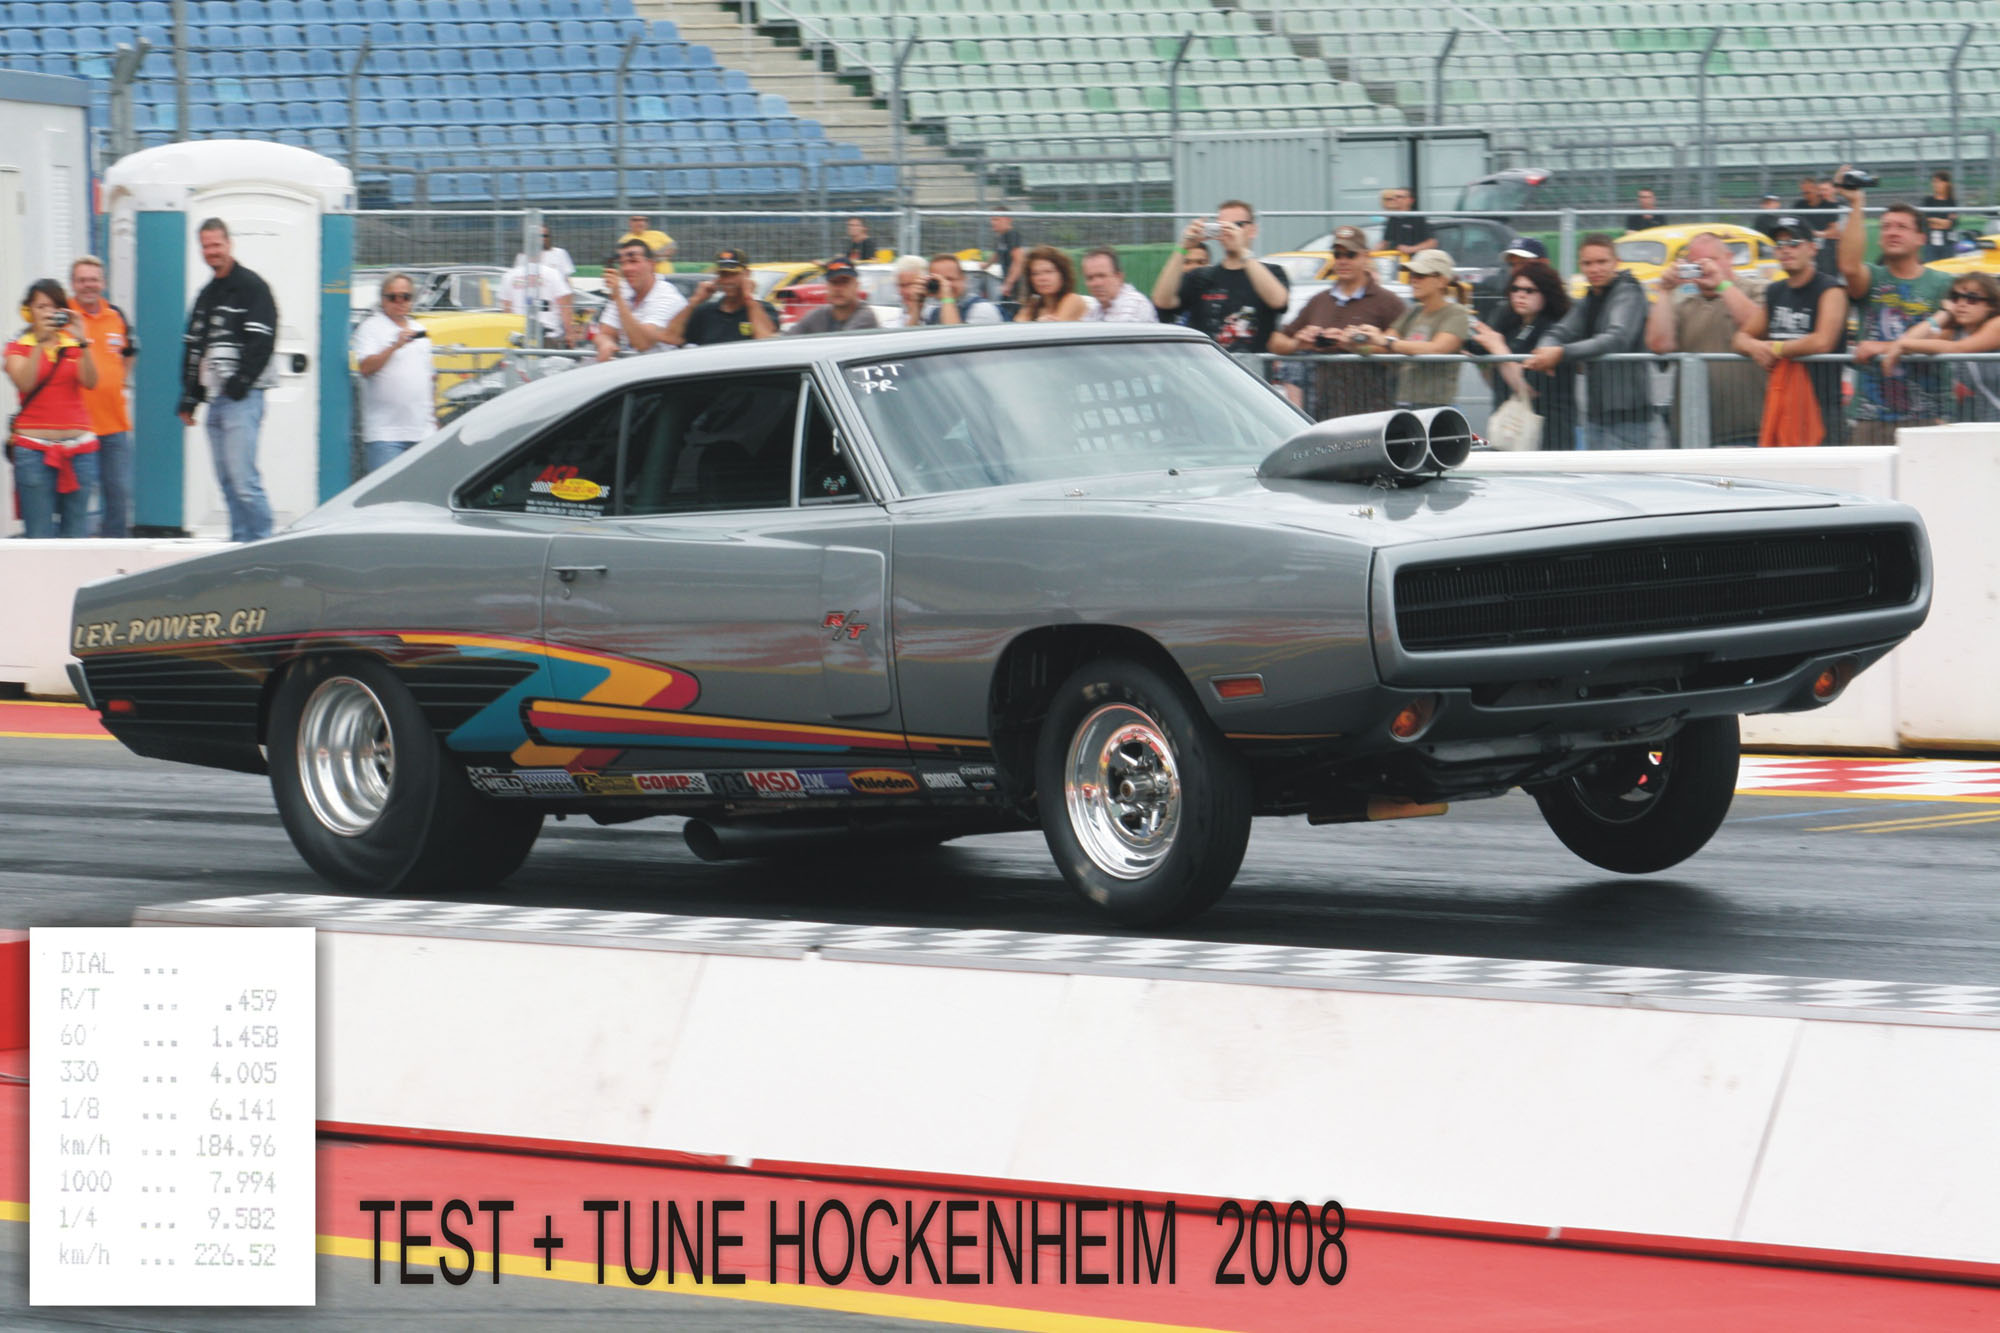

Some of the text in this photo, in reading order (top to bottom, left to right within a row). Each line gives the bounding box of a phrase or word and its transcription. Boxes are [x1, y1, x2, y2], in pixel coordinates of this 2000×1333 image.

[73, 607, 267, 649] LEX-POWER.CH
[822, 609, 869, 640] R/T
[481, 777, 524, 790] WELD
[637, 775, 691, 790] COMP
[746, 771, 801, 792] MSD
[853, 776, 915, 789] Milodon
